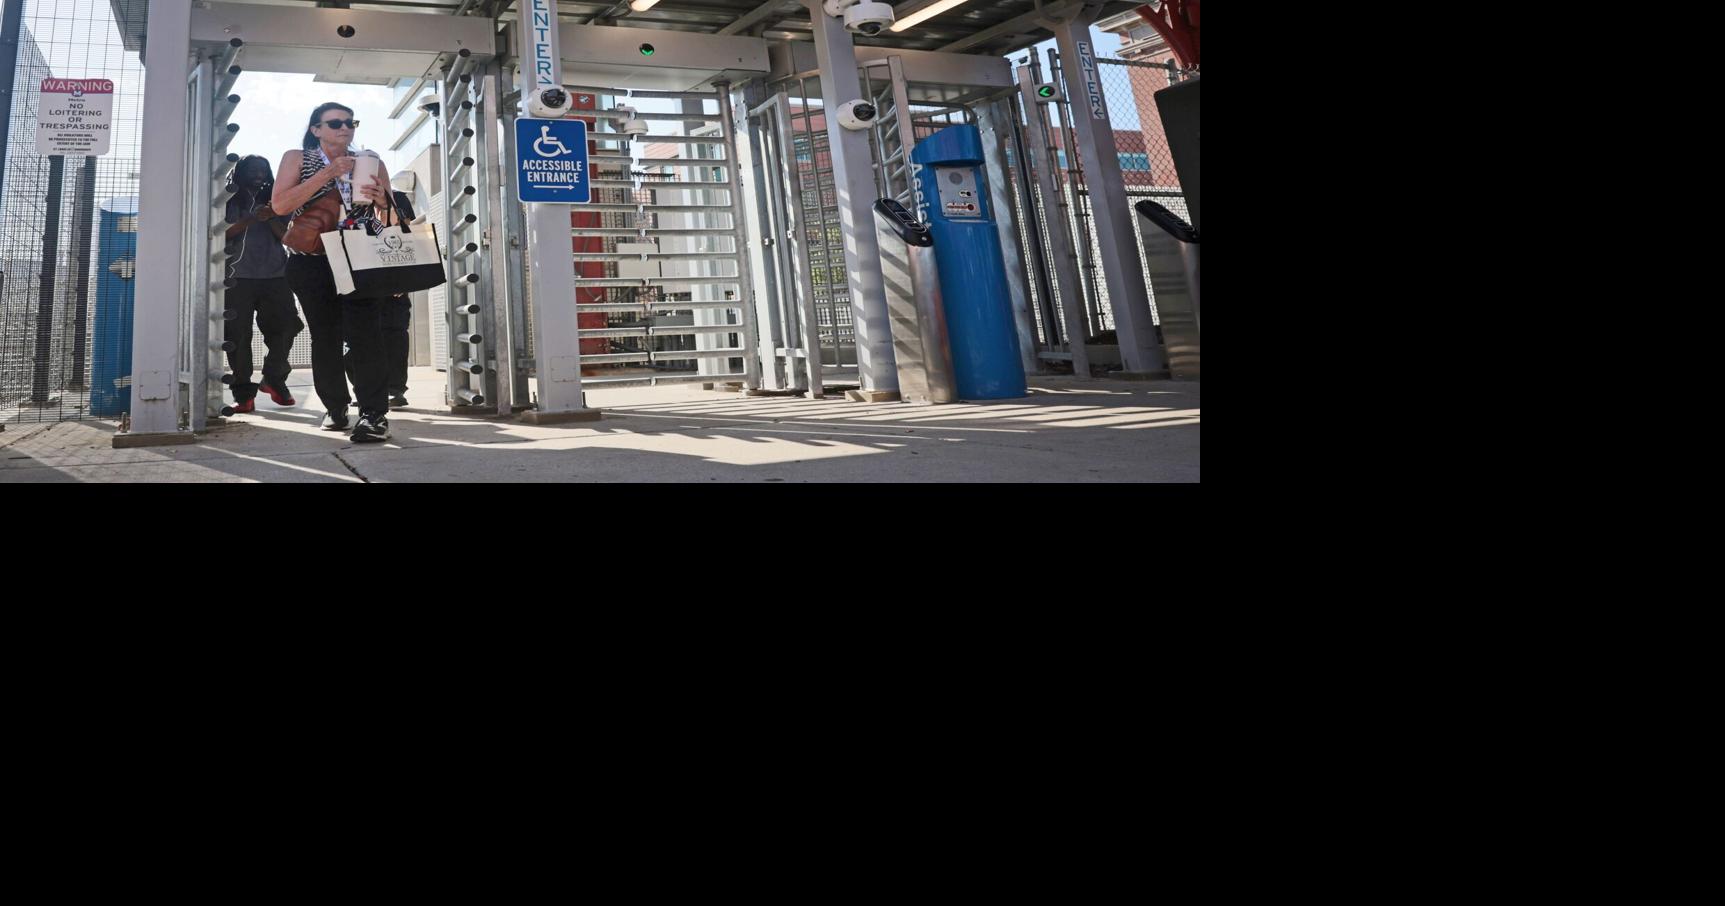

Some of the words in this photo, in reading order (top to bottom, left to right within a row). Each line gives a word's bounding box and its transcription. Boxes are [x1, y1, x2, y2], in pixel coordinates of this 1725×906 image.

[533, 0, 552, 76] ENTER
[1079, 43, 1101, 107] ENTER
[43, 81, 112, 91] WARNING
[522, 159, 583, 172] ACCESSIBLE
[527, 171, 580, 183] ENTRANCE
